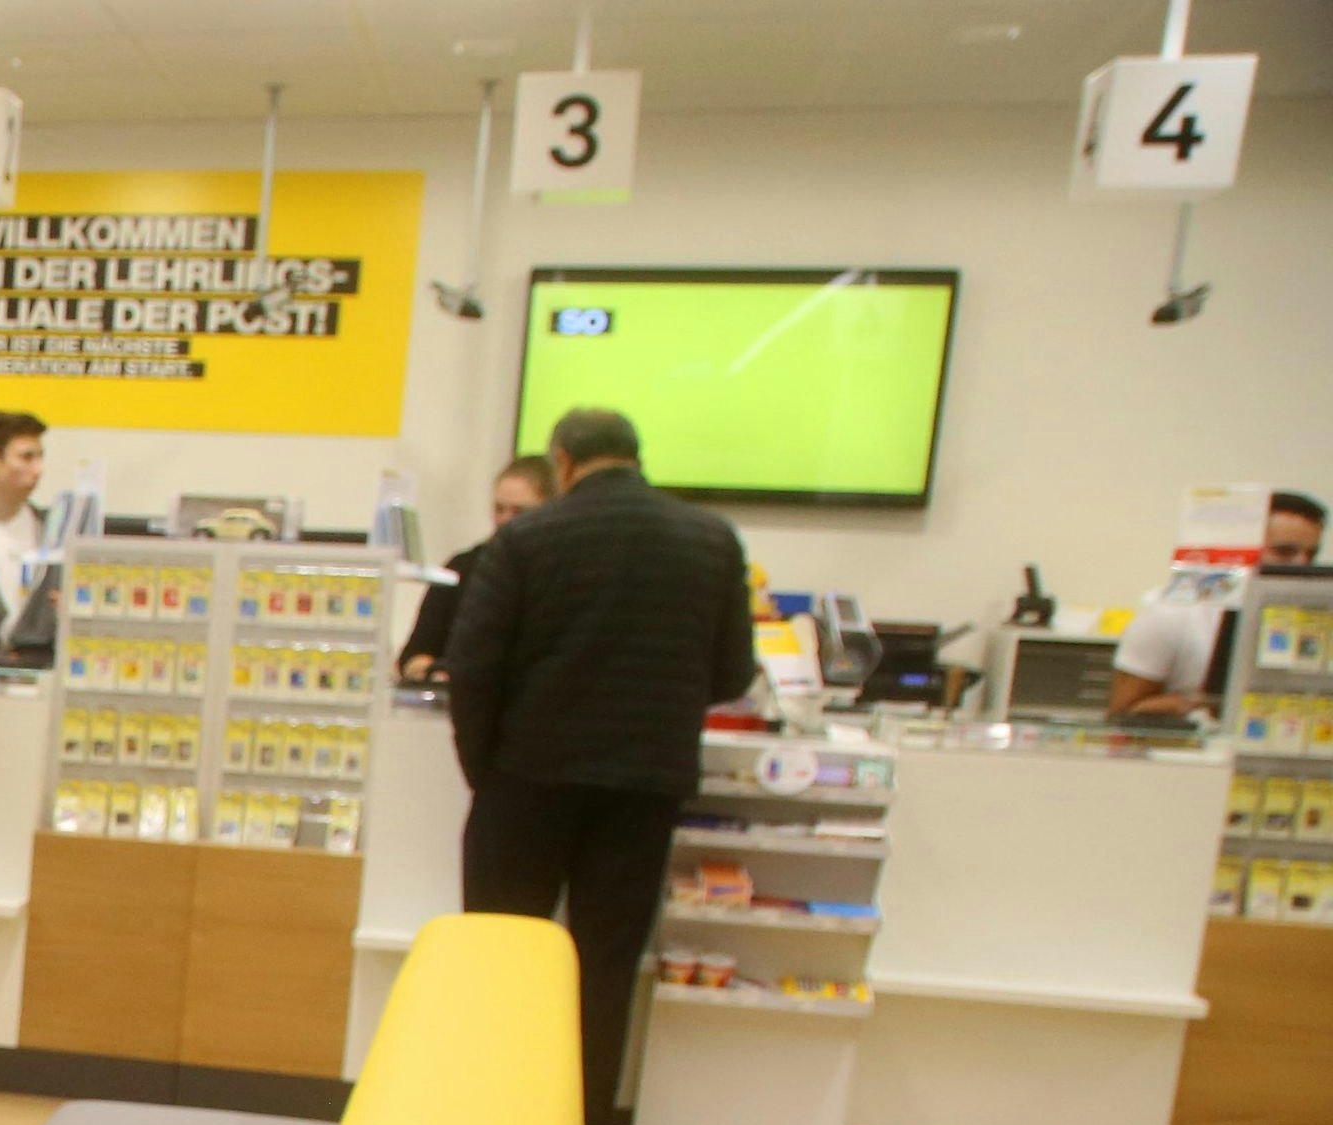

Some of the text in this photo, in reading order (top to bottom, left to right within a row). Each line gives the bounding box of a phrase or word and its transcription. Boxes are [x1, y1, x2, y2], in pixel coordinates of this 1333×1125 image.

[548, 94, 601, 169] 3
[1140, 82, 1206, 162] 4
[14, 258, 96, 290] DER
[113, 300, 197, 332] DER
